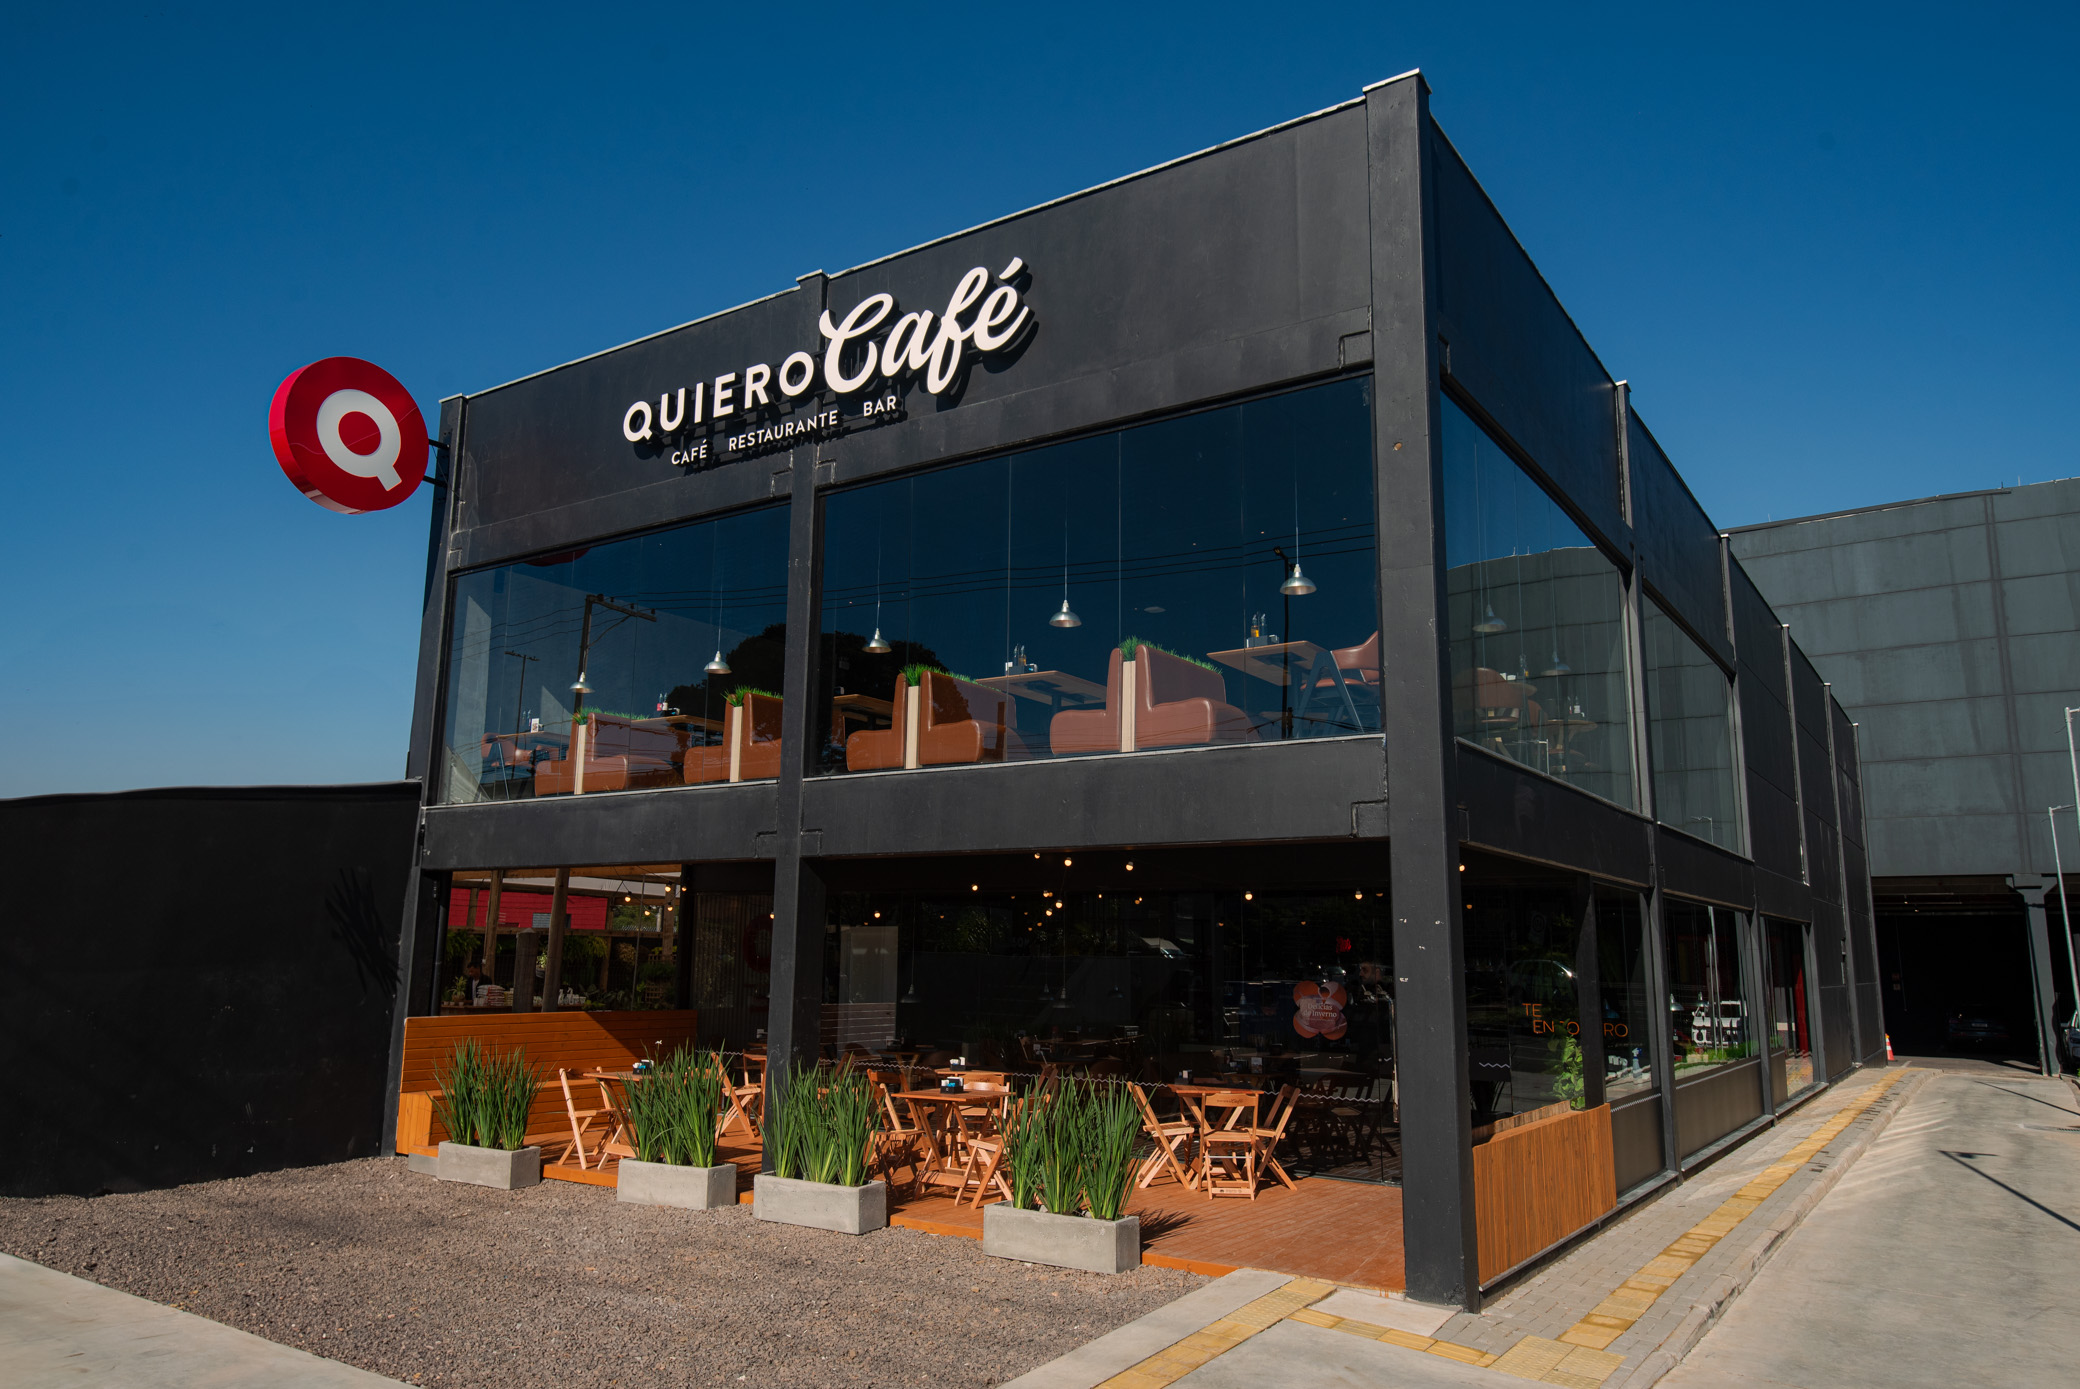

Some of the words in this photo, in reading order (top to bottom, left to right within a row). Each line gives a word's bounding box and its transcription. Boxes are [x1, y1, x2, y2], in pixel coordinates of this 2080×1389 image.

[622, 351, 815, 442] QUIERO
[818, 256, 1030, 395] Café
[316, 388, 403, 492] Q
[671, 439, 708, 466] CAFÉ
[728, 410, 839, 452] RESTAURANTE
[863, 395, 897, 417] BAR
[1312, 1010, 1338, 1018] Inverno
[1521, 1003, 1543, 1018] TE
[1532, 1019, 1629, 1038] ENORO
